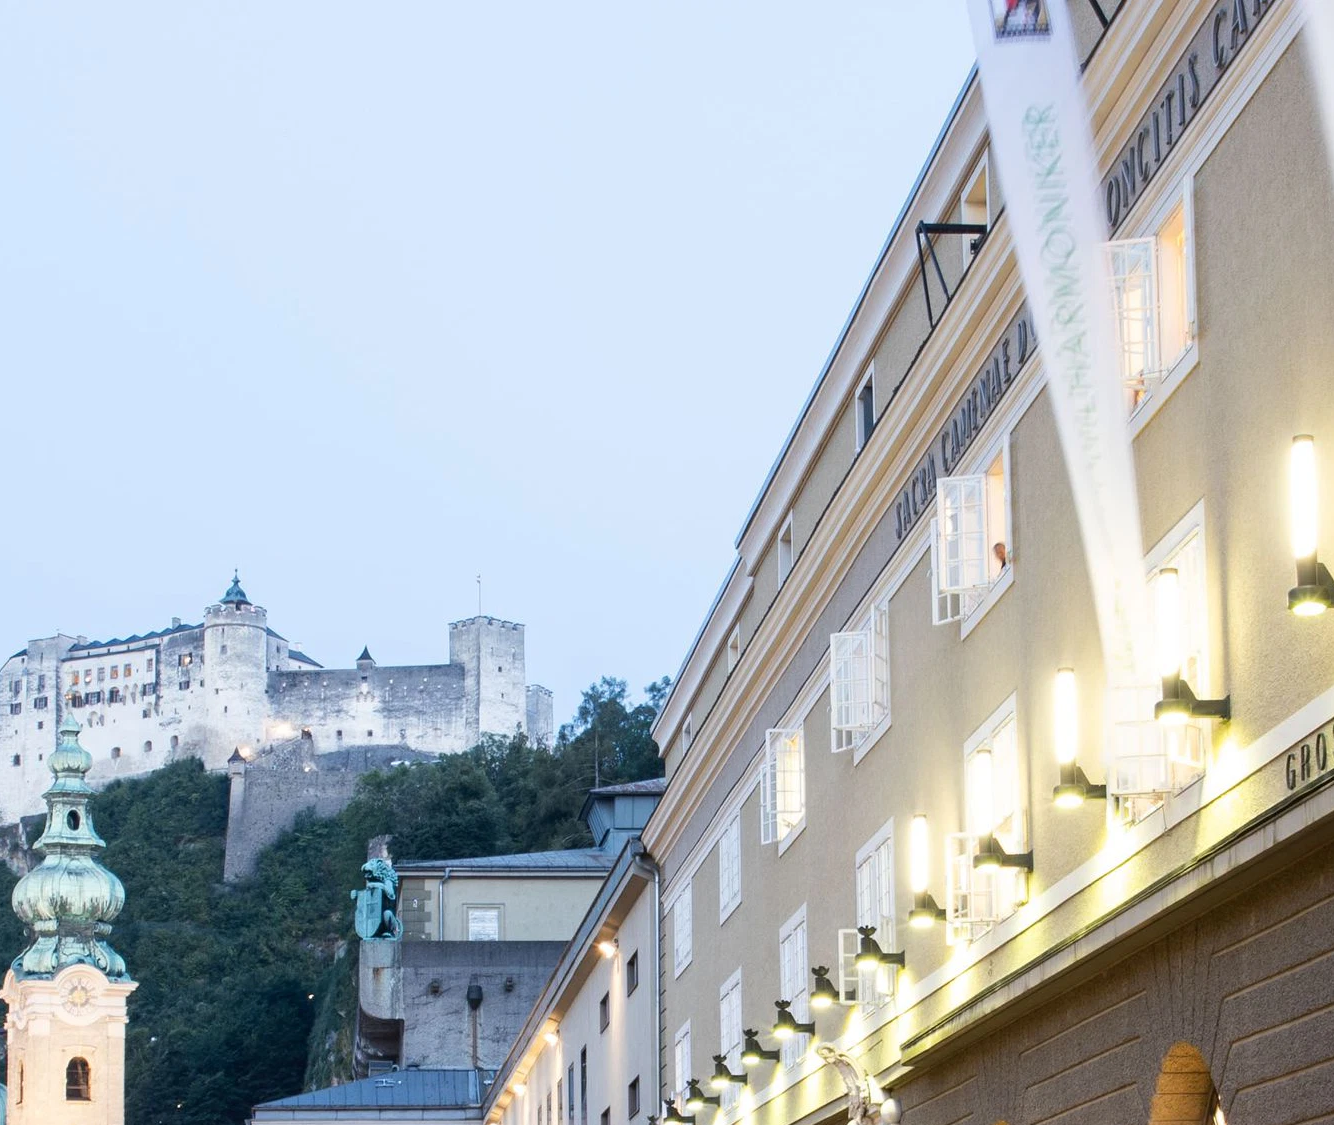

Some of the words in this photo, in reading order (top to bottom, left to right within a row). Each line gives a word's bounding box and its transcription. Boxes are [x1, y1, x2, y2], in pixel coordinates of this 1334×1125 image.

[895, 453, 937, 540] SACRA
[941, 337, 1012, 473] CAMENAE
[1106, 52, 1201, 228] ONCITIS
[1021, 102, 1101, 470] LHARMONIKER
